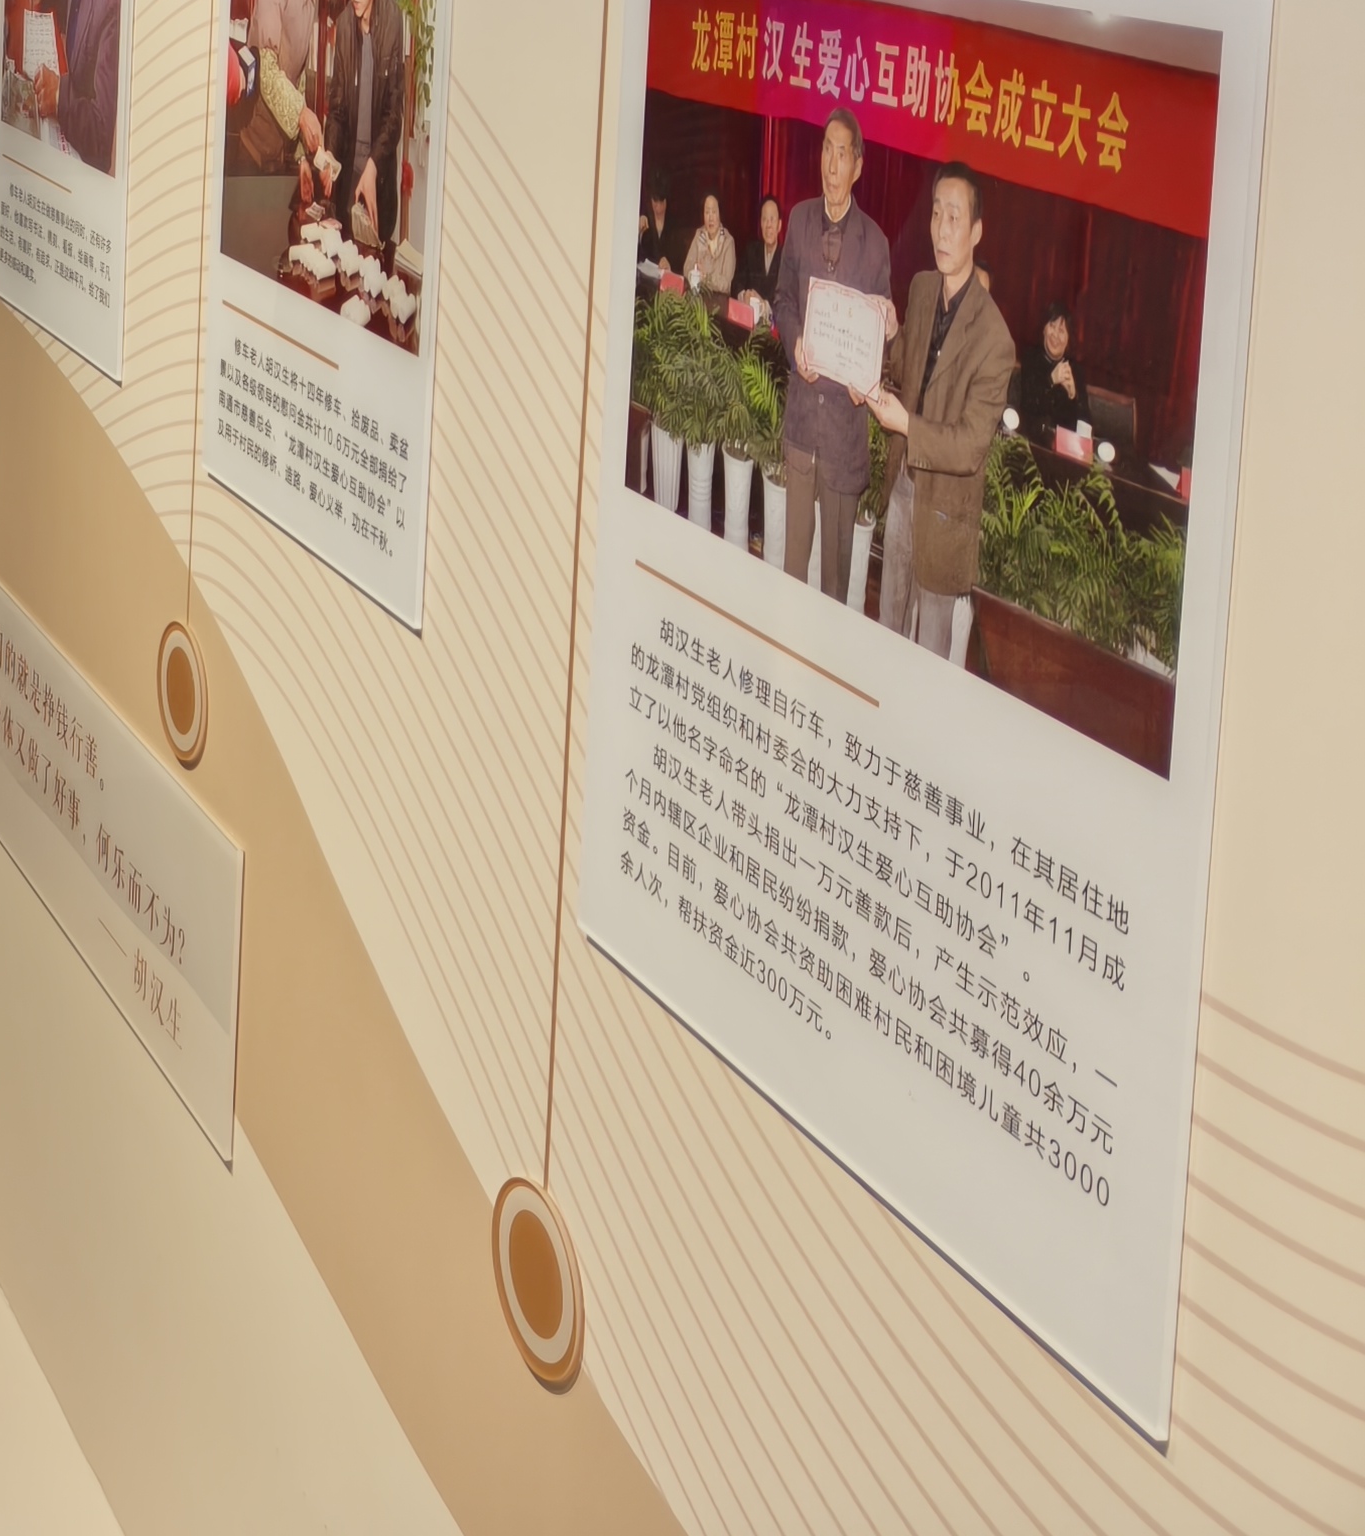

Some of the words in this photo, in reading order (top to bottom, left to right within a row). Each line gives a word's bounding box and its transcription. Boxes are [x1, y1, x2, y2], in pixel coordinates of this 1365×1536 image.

[691, 7, 1130, 173] 龙潭村汉生爱心互助协会成立大会
[628, 685, 1034, 984] 立了以他名字命名的“龙潭村汉生爱心互助协会”。
[630, 641, 1126, 992] 的龙潭村党组织和村委会的大力支持下，于2011年11月成
[652, 743, 1119, 1090] 胡汉生老人带头捐出一万元善款后，产生示范效应，一
[659, 616, 1130, 935] 胡汉生老人修理自行车，致力于慈善事业，在其居住地
[619, 848, 835, 1043] 余人次，帮扶资金近300万元。
[621, 805, 1110, 1209] 资金。目前，爱心协会共资助困难村民和困境儿童共3000
[624, 767, 1114, 1158] 个月内辖区企业和居民纷纷捐款，爱心协会共募得40余万元
